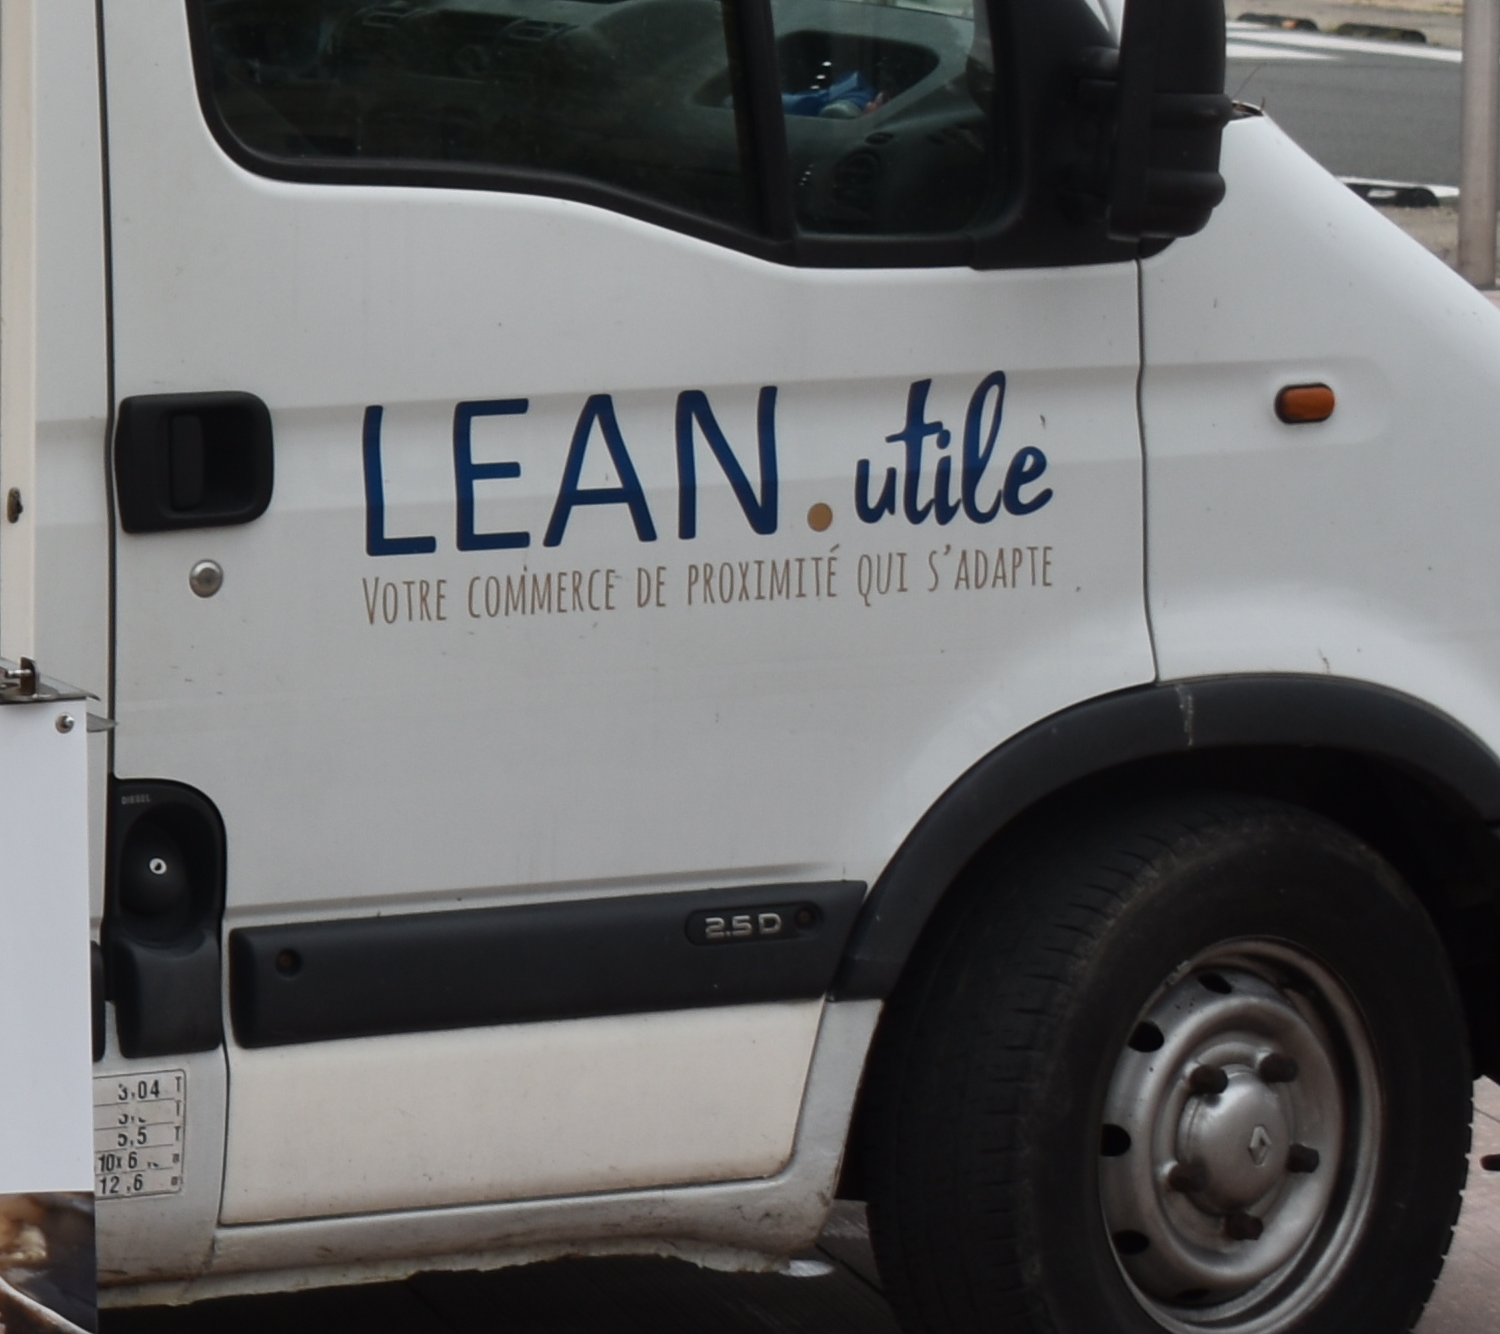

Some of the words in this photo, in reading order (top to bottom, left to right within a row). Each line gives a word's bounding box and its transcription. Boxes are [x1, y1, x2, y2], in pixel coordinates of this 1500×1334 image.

[362, 385, 777, 557] LEAN
[854, 371, 1053, 526] utile
[468, 567, 616, 617] COMMERCE
[635, 564, 666, 609] DE
[686, 543, 838, 604] PROXIMITÉ
[857, 551, 909, 599] QUI
[927, 540, 1054, 596] S'ADAPTE
